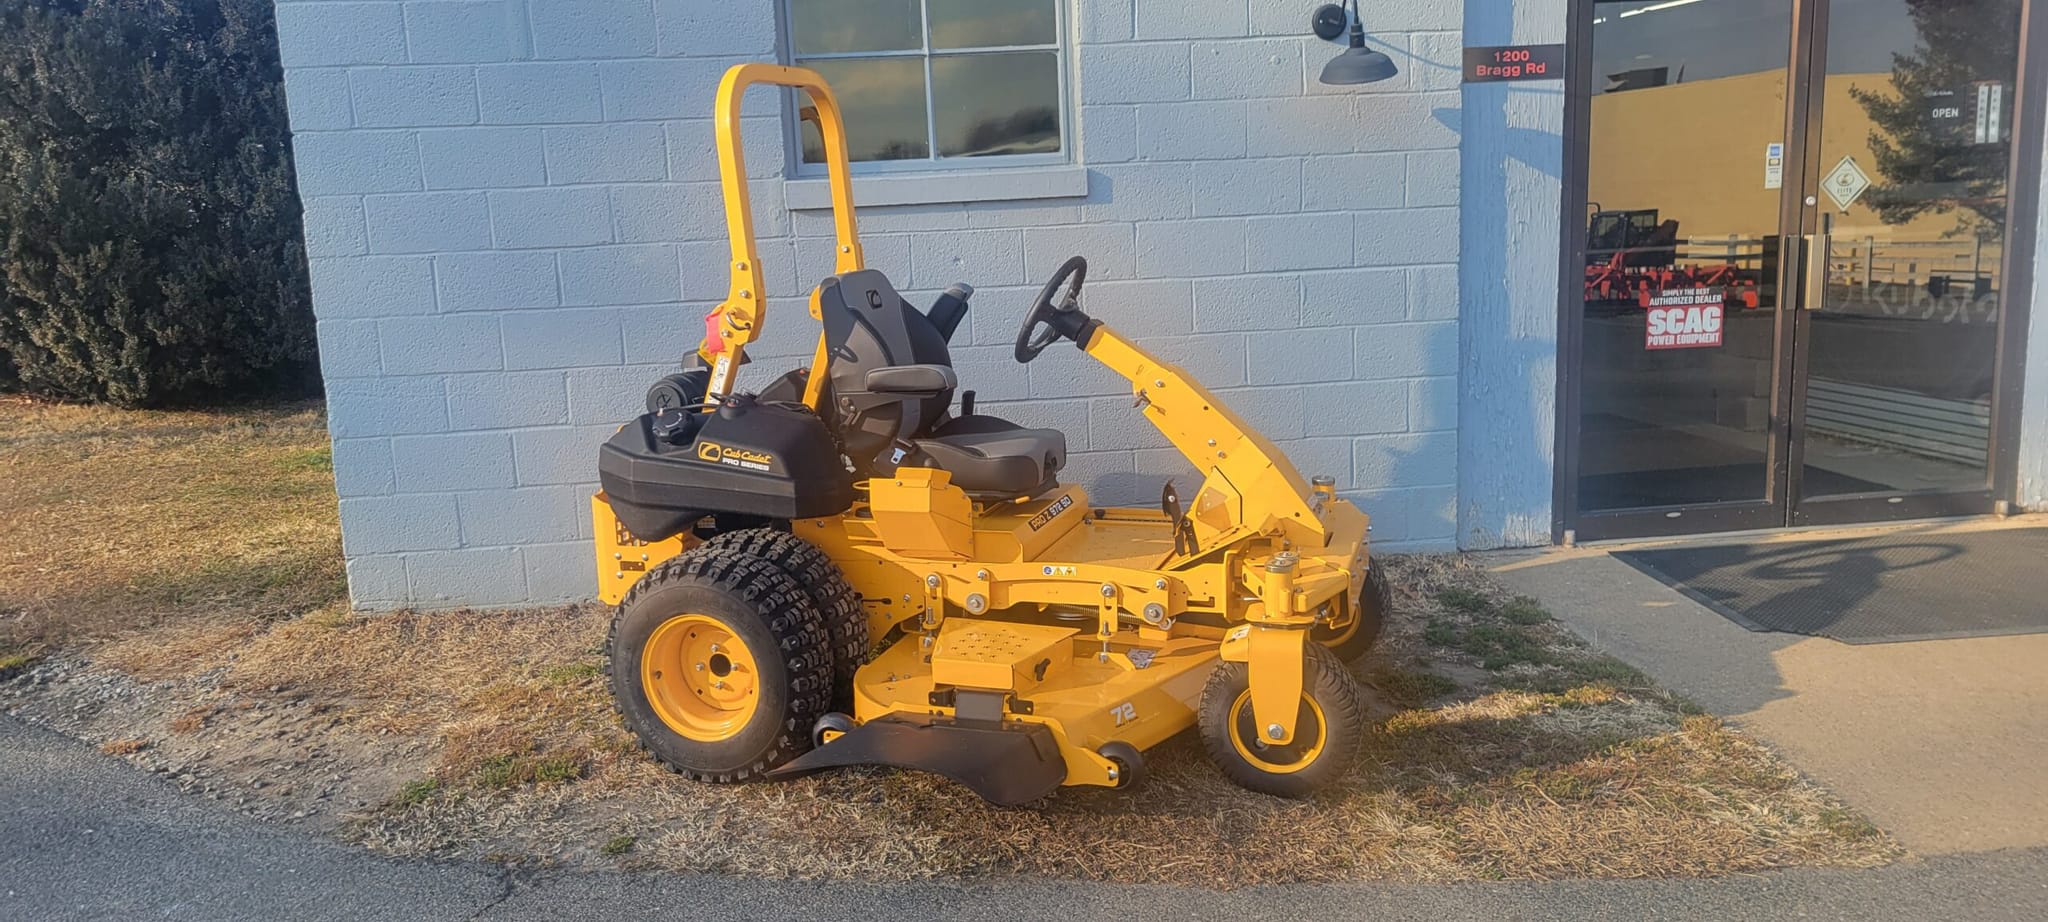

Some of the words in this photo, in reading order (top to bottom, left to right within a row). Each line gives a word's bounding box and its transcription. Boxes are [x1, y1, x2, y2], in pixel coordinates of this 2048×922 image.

[1494, 50, 1530, 62] 1200
[1476, 64, 1520, 77] Bragg
[1525, 62, 1546, 74] Rd
[1932, 107, 1959, 118] OPEN
[1662, 288, 1683, 297] SIMPLY
[1684, 288, 1695, 296] THE
[1696, 287, 1710, 295] BEST
[1649, 296, 1693, 306] AUTHORIZED
[1695, 294, 1722, 304] DEALER
[1648, 306, 1721, 334] SCAG
[1647, 335, 1675, 346] POWER
[1676, 332, 1720, 345] EQUIPMENT
[722, 447, 741, 458] Cub
[741, 451, 772, 464] Cadet
[722, 457, 740, 466] PRO
[741, 461, 769, 471] SERIES
[1031, 514, 1047, 529] PRO
[1043, 510, 1052, 520] Z
[1049, 502, 1063, 516] 972
[1110, 702, 1137, 726] 72
